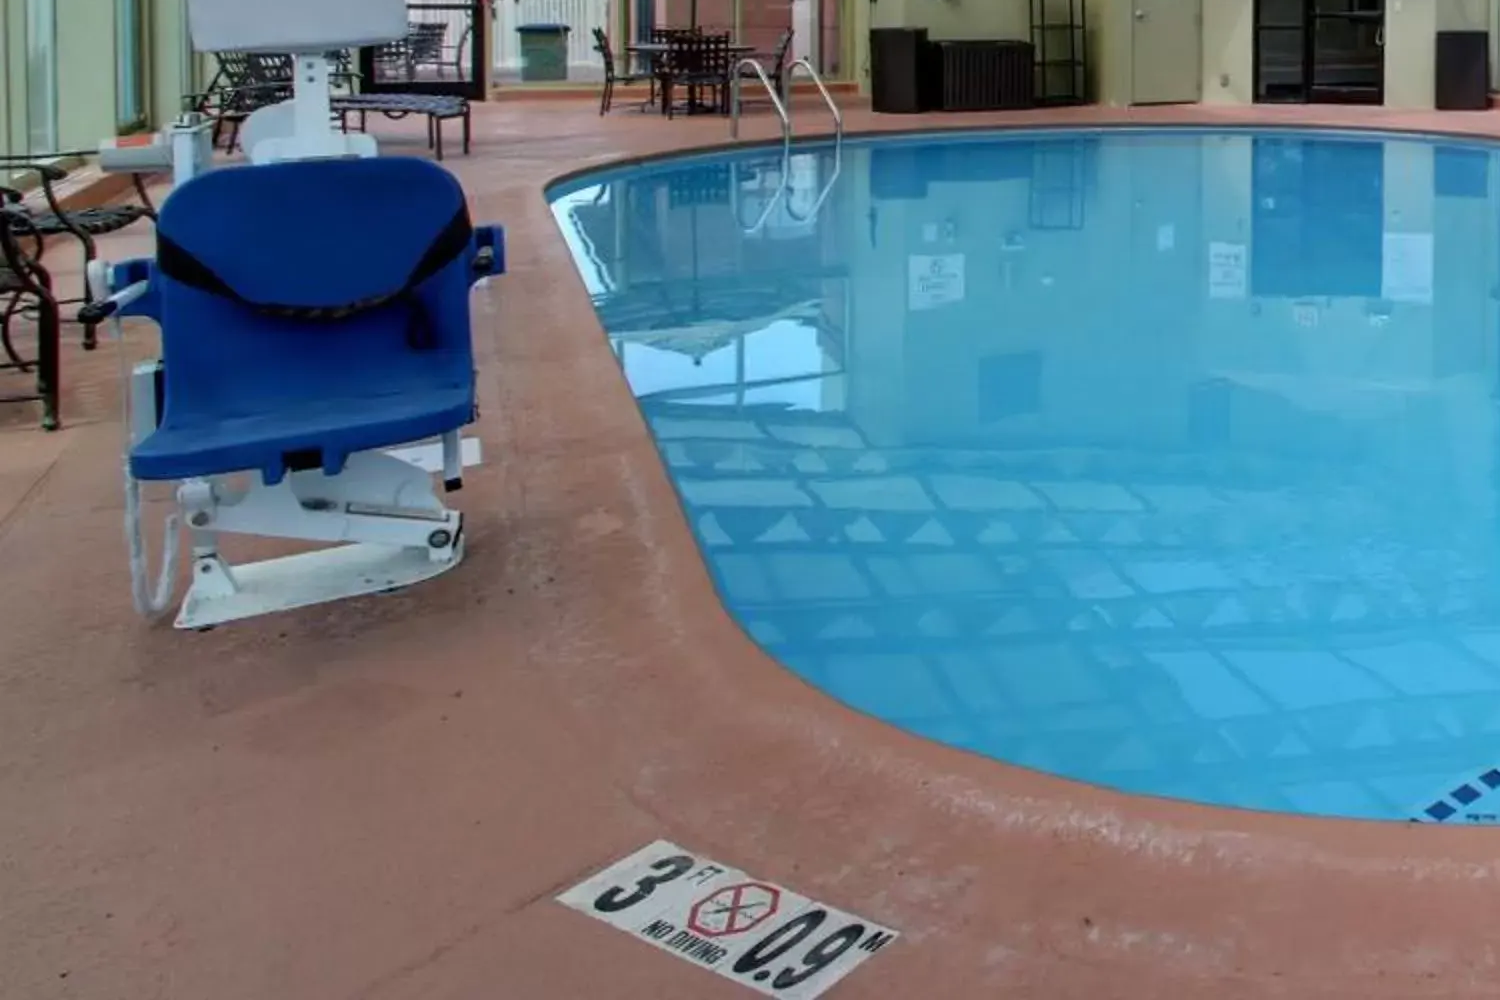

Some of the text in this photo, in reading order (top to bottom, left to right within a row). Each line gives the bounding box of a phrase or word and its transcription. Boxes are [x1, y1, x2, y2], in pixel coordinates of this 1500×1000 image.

[594, 855, 694, 912] 3
[732, 909, 865, 990] 0.9
[858, 931, 894, 953] M
[641, 919, 728, 965] NO DIVING
